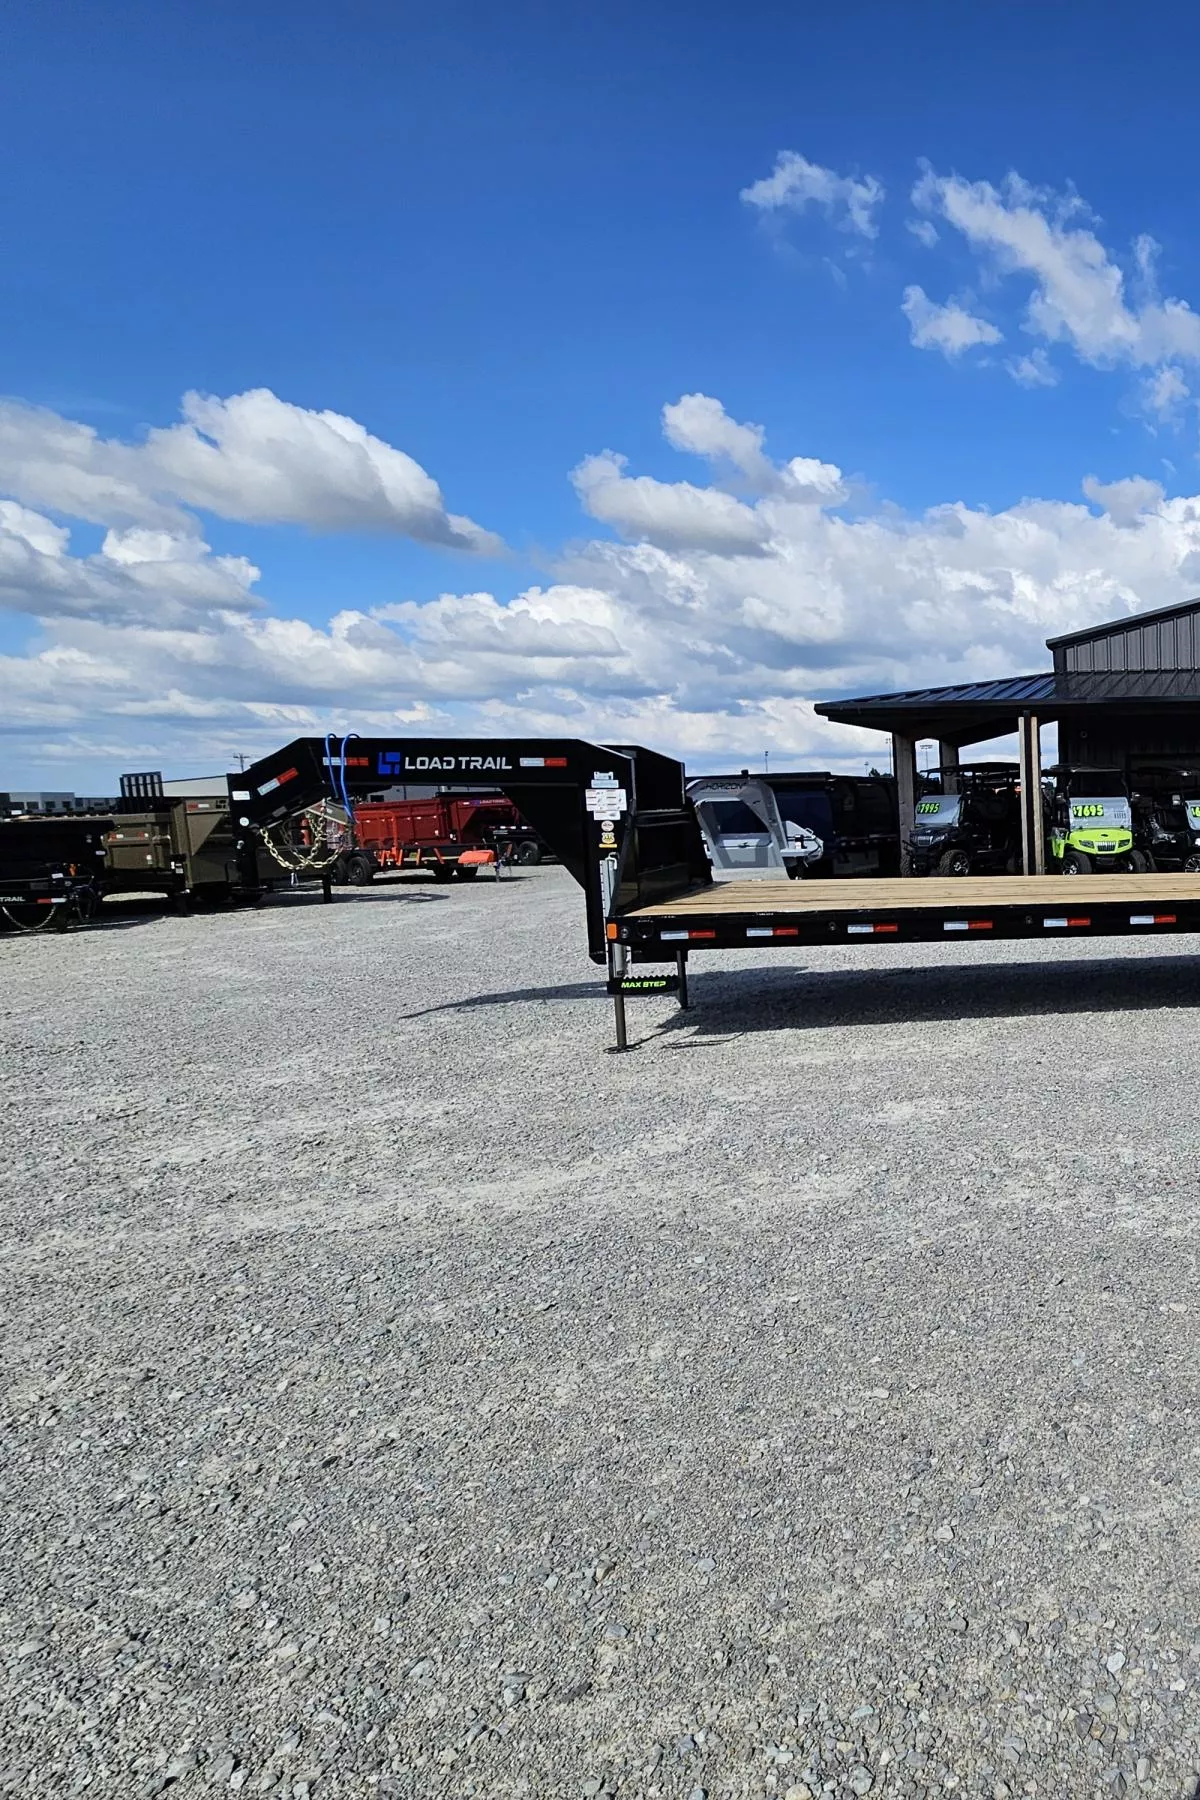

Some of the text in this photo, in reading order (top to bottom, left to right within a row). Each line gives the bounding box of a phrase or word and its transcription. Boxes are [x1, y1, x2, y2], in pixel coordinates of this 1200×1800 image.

[404, 756, 513, 770] LOAD TRAIL
[1073, 804, 1104, 817] $7695
